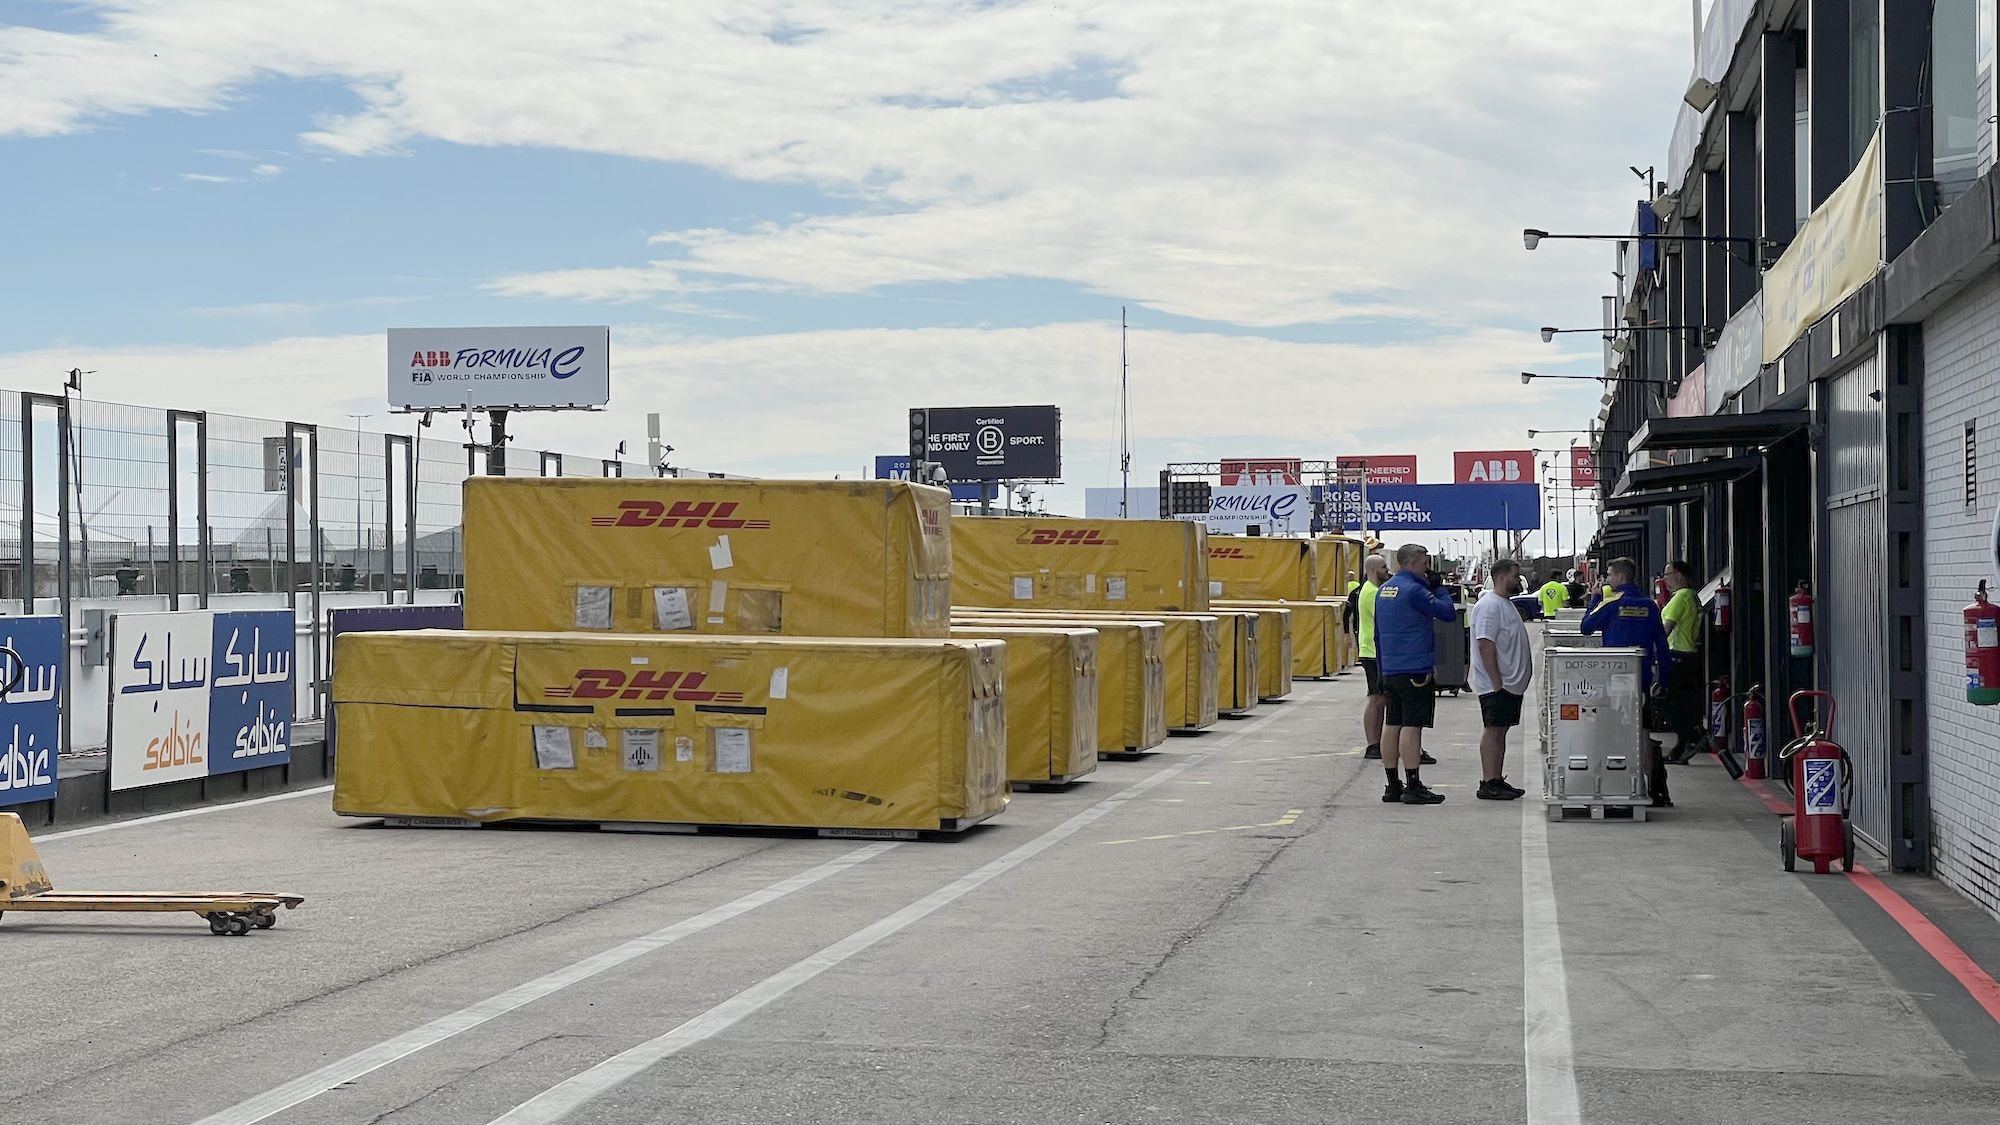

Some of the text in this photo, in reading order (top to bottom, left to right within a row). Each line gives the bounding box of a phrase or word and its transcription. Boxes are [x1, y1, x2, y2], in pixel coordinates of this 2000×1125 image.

[410, 351, 450, 367] ABB
[453, 348, 552, 369] FORMULA
[975, 418, 1004, 426] Certified
[928, 433, 971, 442] HE FIRST
[983, 431, 998, 449] B
[1009, 437, 1045, 446] SPORT.
[927, 442, 970, 451] ND ONLY
[1469, 460, 1521, 481] ABB
[1208, 494, 1272, 511] RMULA
[1374, 501, 1421, 512] RAVAL
[615, 501, 746, 529] DHL
[1384, 511, 1432, 523] E-PRIX
[1031, 530, 1105, 545] DHL
[1565, 661, 1628, 670] DOT-SP 21721
[572, 669, 717, 701] DHL
[233, 700, 287, 759] sabic
[143, 709, 203, 771] sabic
[0, 723, 52, 791] abic
